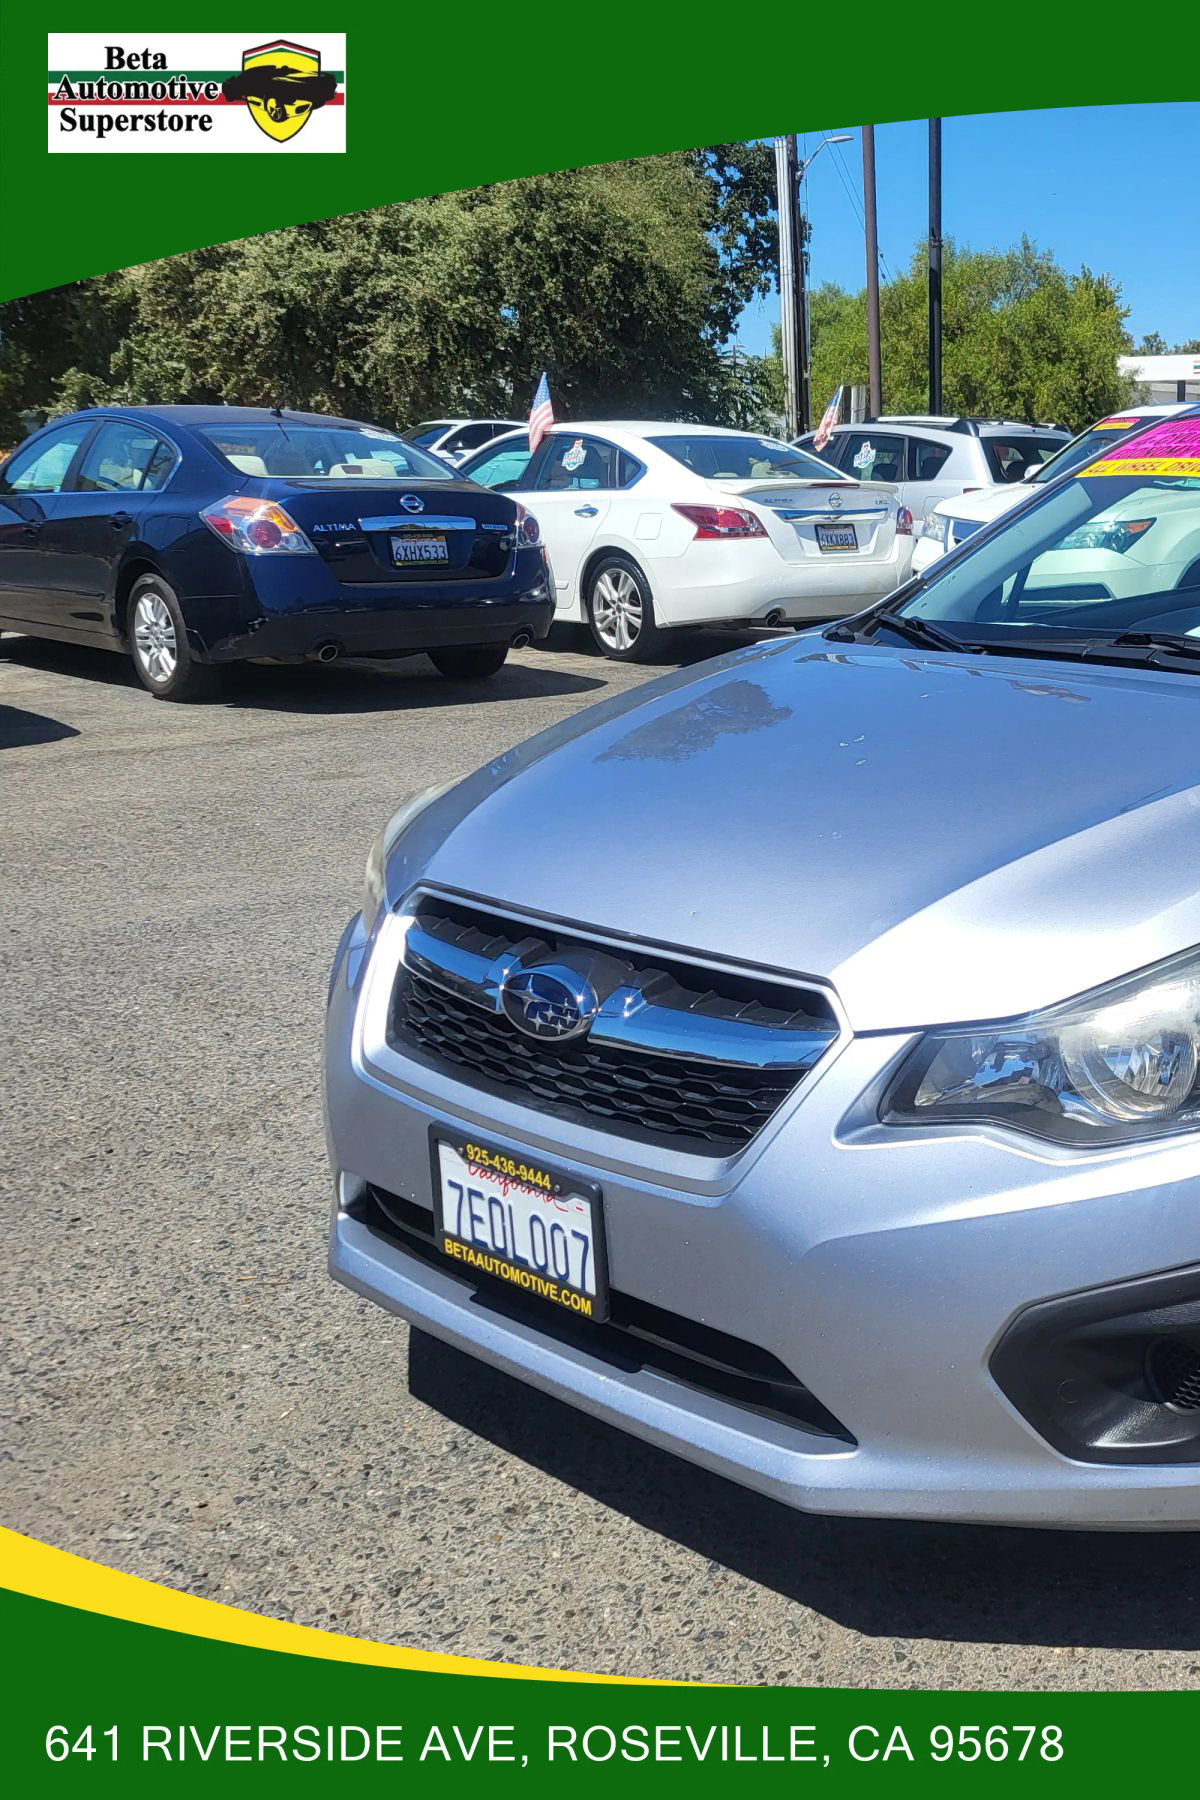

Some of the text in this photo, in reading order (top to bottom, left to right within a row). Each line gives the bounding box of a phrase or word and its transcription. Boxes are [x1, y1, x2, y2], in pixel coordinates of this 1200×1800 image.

[312, 523, 357, 533] ALTIMA
[395, 544, 447, 561] 6XHX533
[466, 1143, 552, 1191] 925-436-9444
[444, 1238, 592, 1316] BETAAUTOMOTIVE.COM
